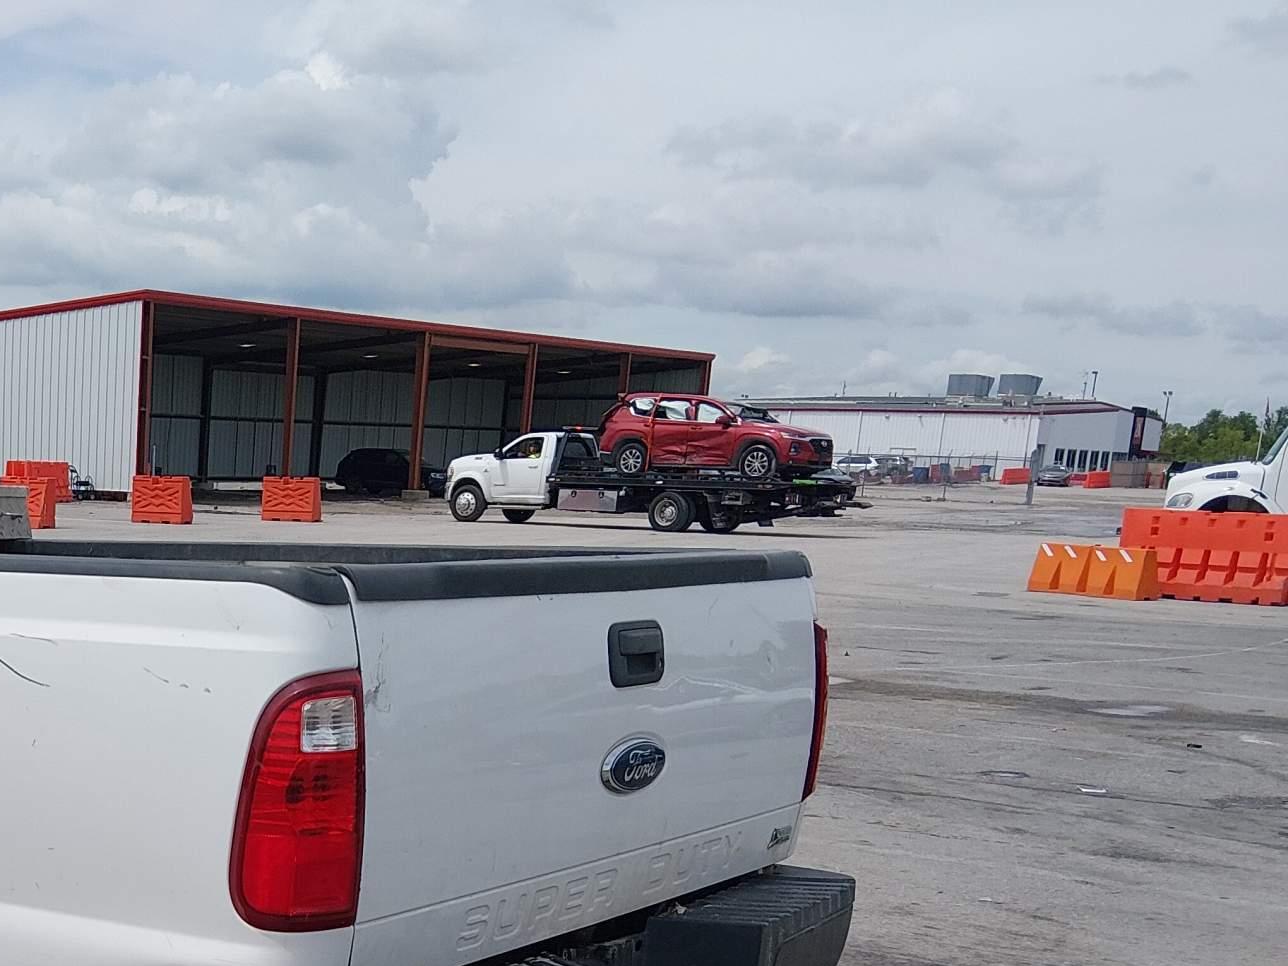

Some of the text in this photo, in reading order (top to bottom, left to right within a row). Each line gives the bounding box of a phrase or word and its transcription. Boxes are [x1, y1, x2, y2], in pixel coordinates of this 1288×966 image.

[621, 748, 663, 783] Ford
[456, 831, 744, 953] SUPER DUTY
